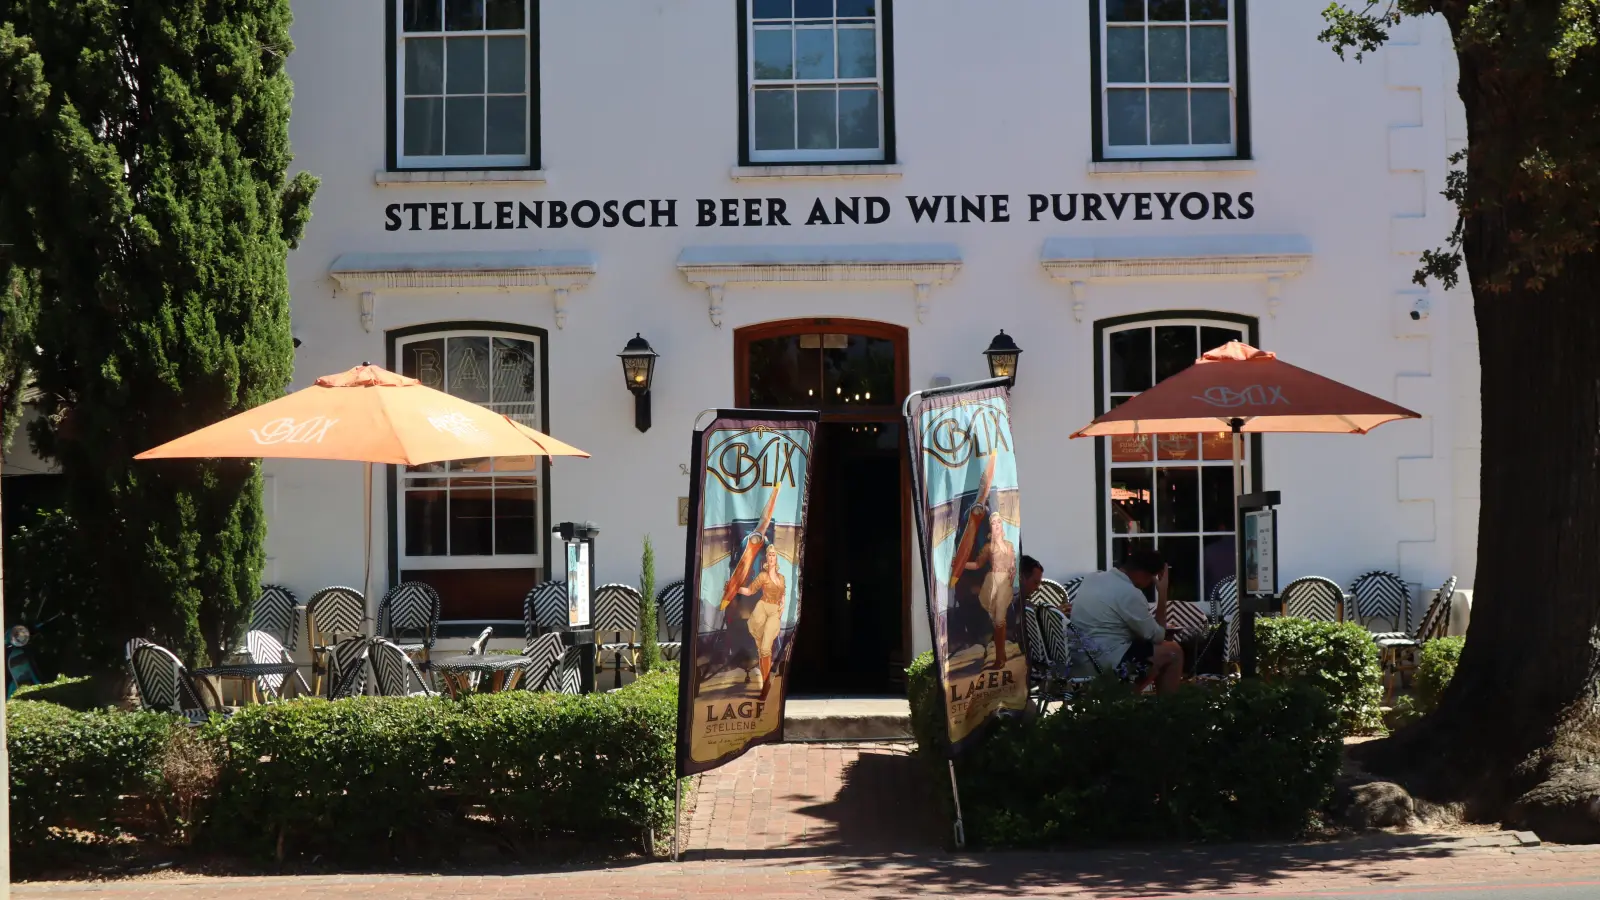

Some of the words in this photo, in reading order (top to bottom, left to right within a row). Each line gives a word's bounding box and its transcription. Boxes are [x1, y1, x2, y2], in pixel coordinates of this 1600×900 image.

[385, 199, 678, 231] STELLENBOSCH
[696, 198, 791, 227] BEER
[805, 197, 890, 225] AND
[906, 194, 1010, 223] WINE
[1028, 191, 1254, 221] PURVEYORS
[413, 348, 529, 388] BAR
[1191, 384, 1292, 407] BLIX
[248, 415, 340, 445] BLIX
[922, 407, 1010, 468] BLIX
[707, 436, 796, 493] BLIX
[951, 670, 1016, 703] LAGER
